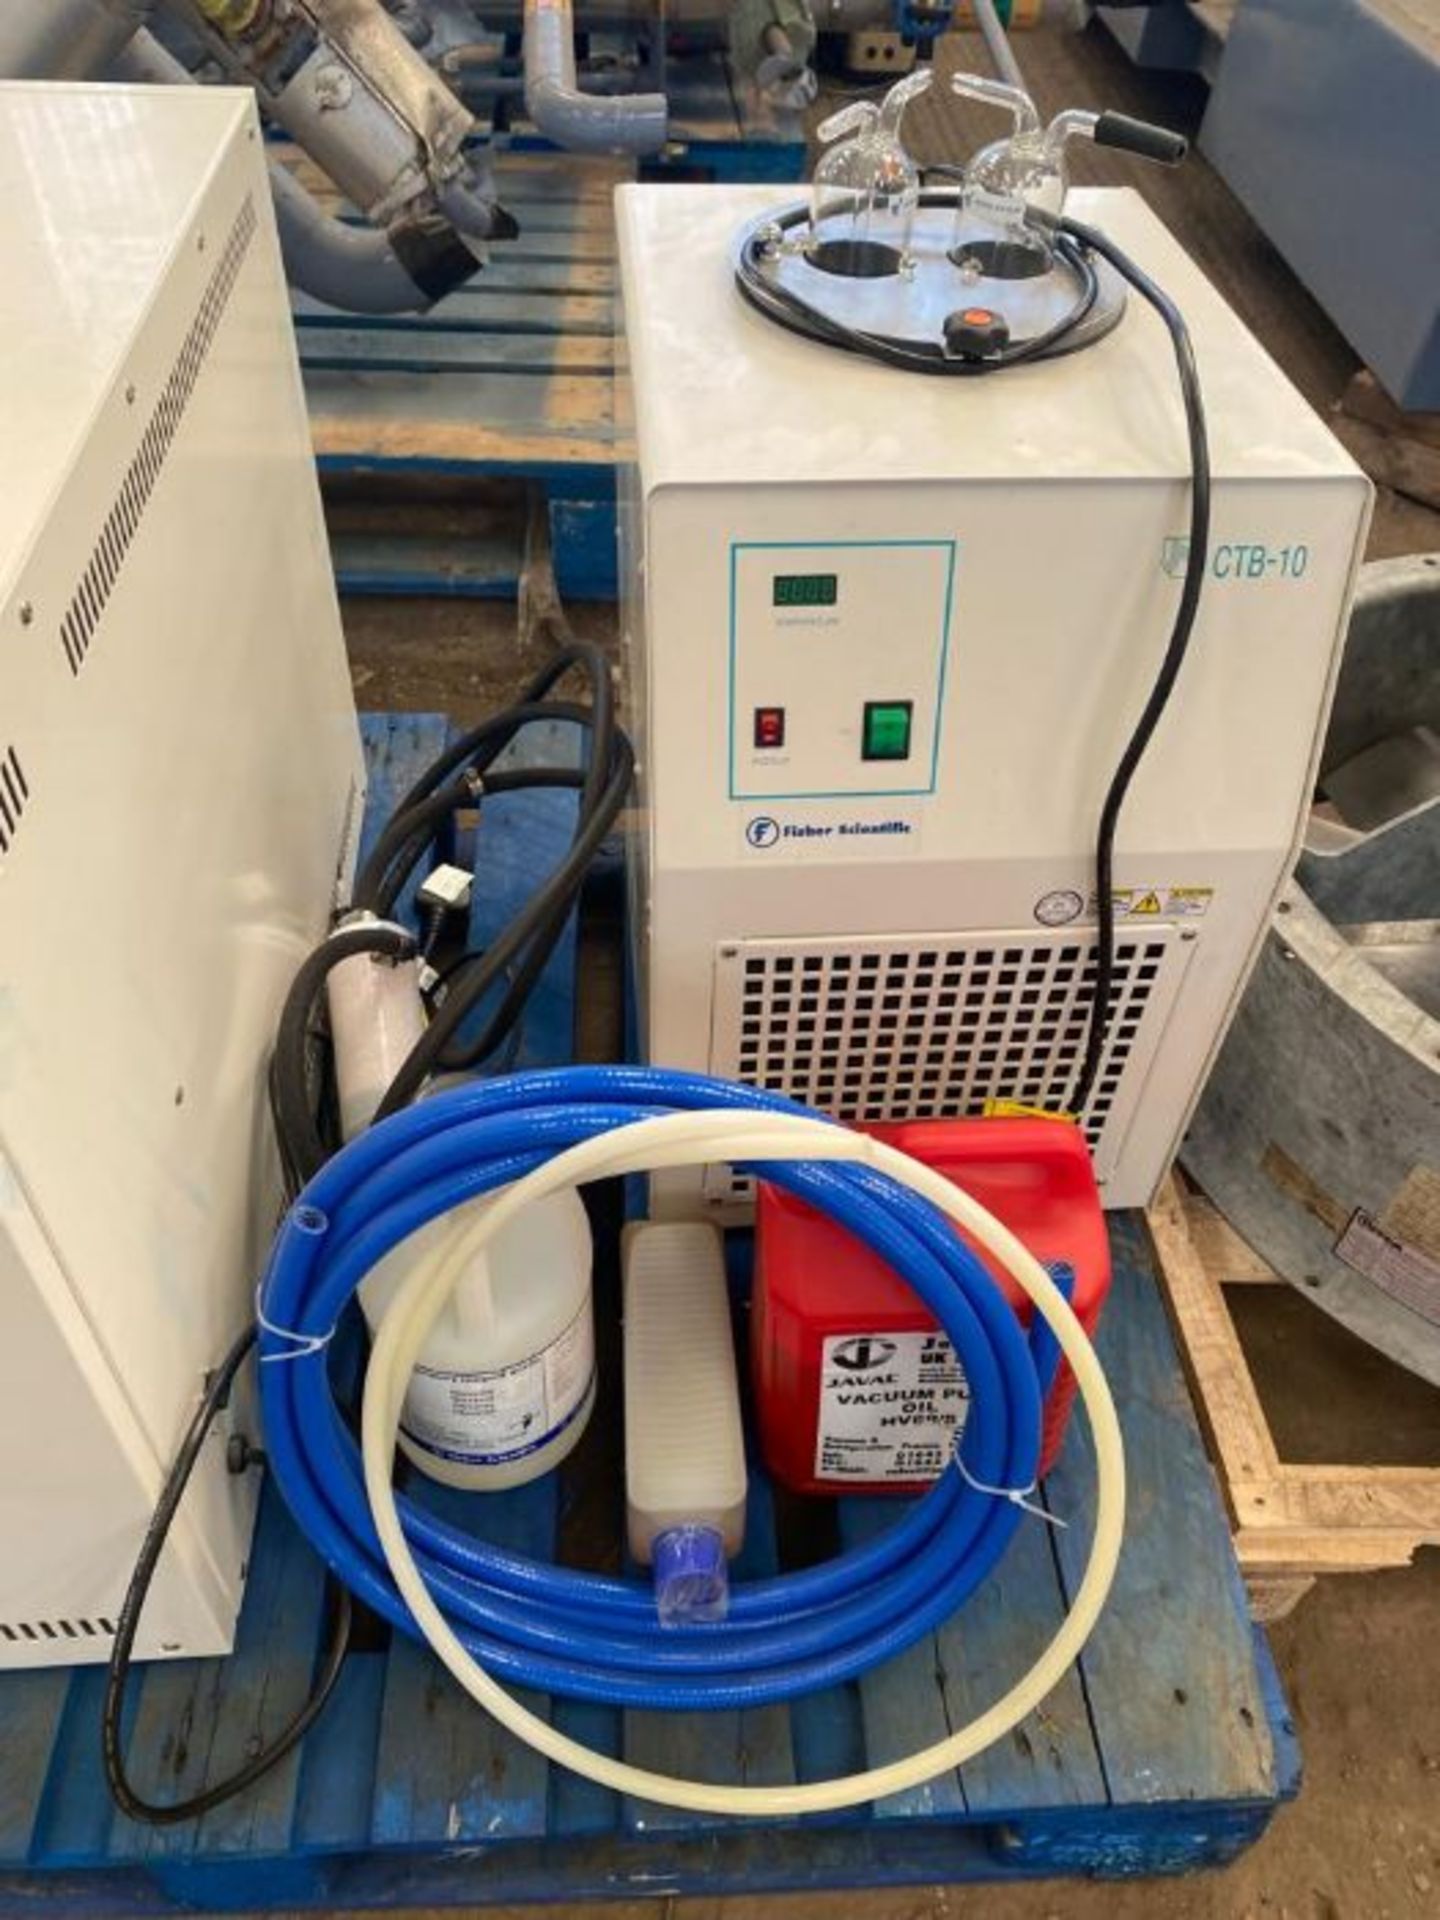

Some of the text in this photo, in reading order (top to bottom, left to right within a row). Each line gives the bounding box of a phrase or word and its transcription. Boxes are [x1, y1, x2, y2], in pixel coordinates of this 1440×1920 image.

[1213, 544, 1308, 578] CTB-10
[837, 1388, 935, 1405] VACUUM
[901, 1401, 938, 1413] OIL
